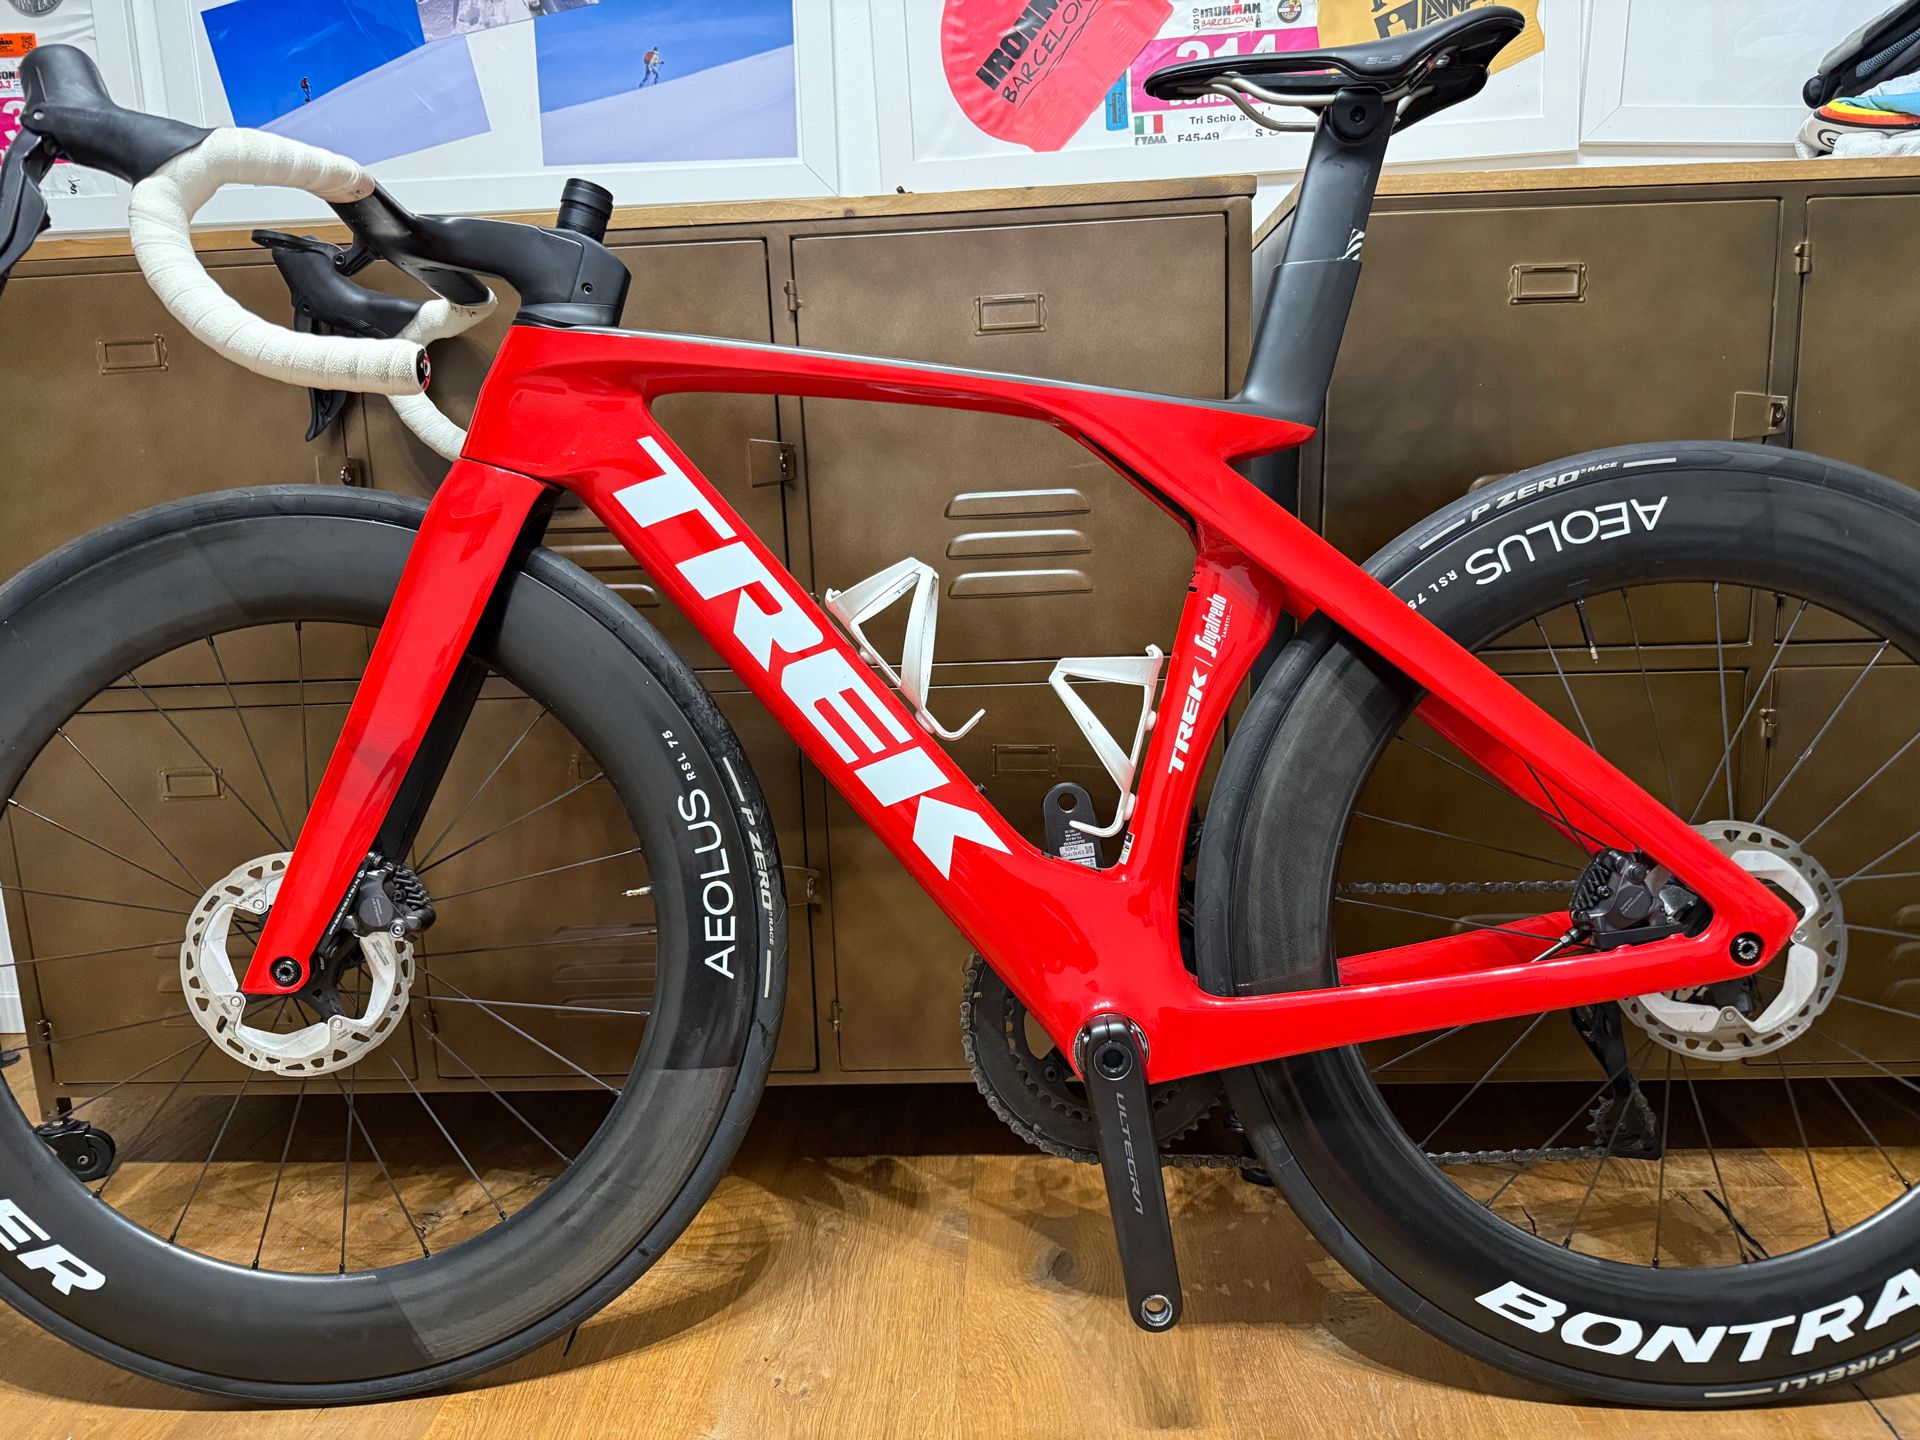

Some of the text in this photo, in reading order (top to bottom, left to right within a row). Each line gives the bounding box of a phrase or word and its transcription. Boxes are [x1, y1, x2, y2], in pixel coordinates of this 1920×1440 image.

[1192, 8, 1200, 30] 2019
[1200, 2, 1262, 18] IRONMAN
[1201, 15, 1254, 27] BARCELONA
[1189, 116, 1203, 125] Tri
[1206, 114, 1236, 124] Schio
[1471, 461, 1618, 523] P ZERO RACE
[1465, 496, 1669, 586] AEOLUS
[1406, 569, 1459, 610] RSL 75
[1194, 592, 1228, 660] Segafredo
[1221, 613, 1232, 639] ZANETTI
[612, 435, 1014, 882] TREK
[1168, 666, 1209, 775] TREK
[661, 730, 697, 782] 75 RSL
[677, 787, 737, 980] AEOLUS
[740, 806, 775, 945] P ZERO RACE
[1116, 1091, 1145, 1216] ULTEGRA
[1777, 1347, 1897, 1394] PIRELLI
